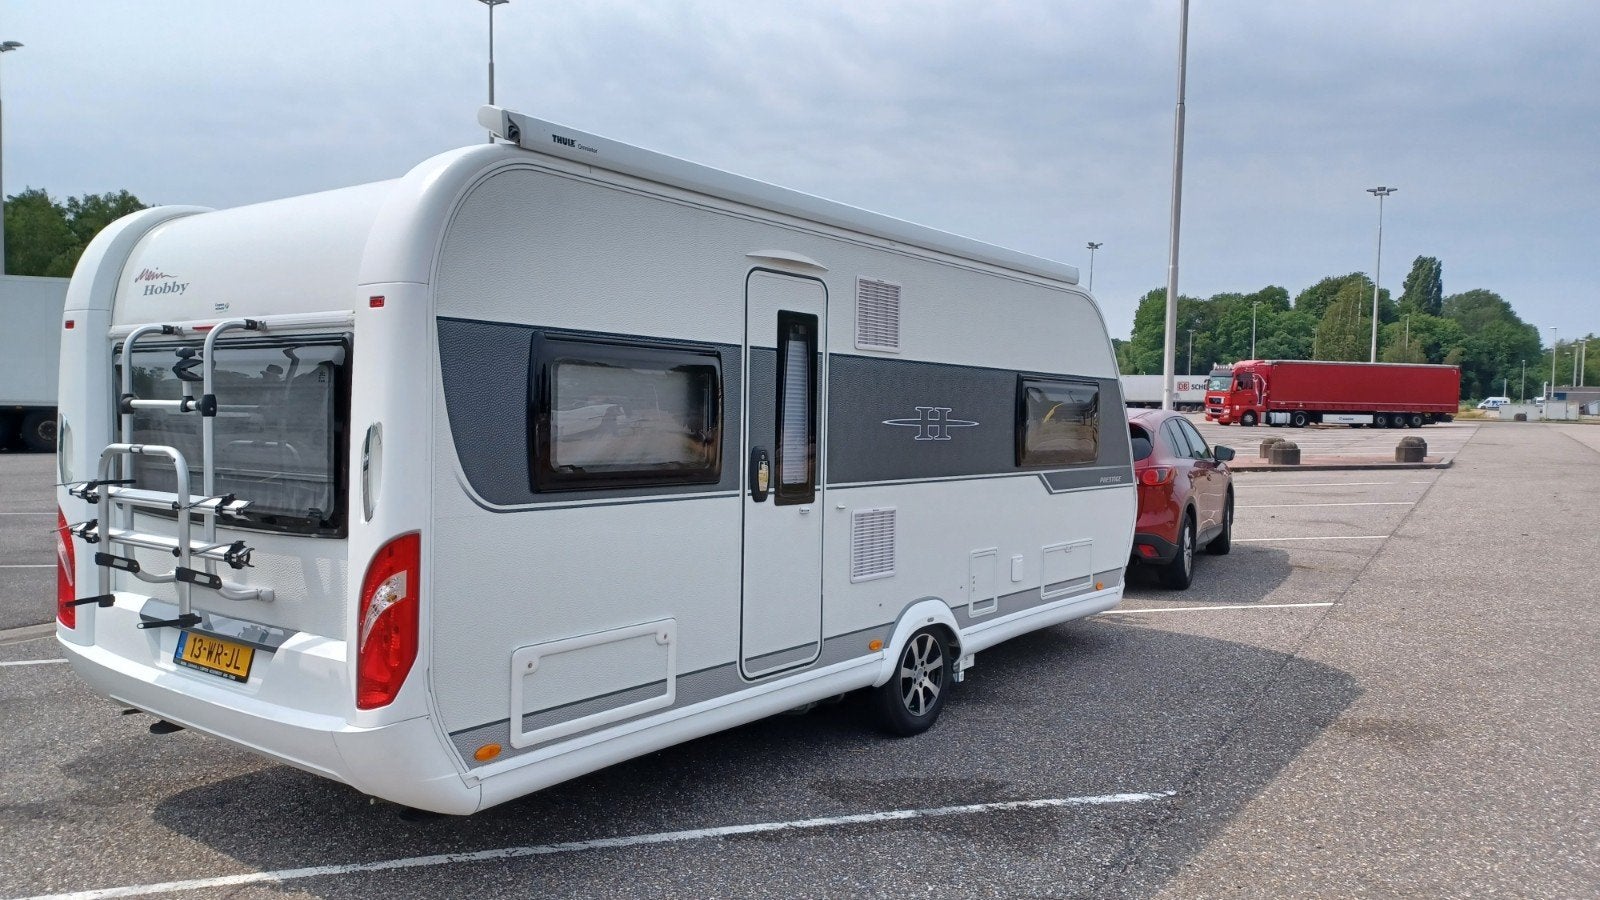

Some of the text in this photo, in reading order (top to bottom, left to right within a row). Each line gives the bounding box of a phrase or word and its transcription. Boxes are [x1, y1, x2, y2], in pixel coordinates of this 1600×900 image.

[552, 134, 576, 147] THULE
[143, 281, 190, 296] Hobby
[1177, 381, 1189, 391] DB
[190, 637, 240, 670] 13-WR-JL
